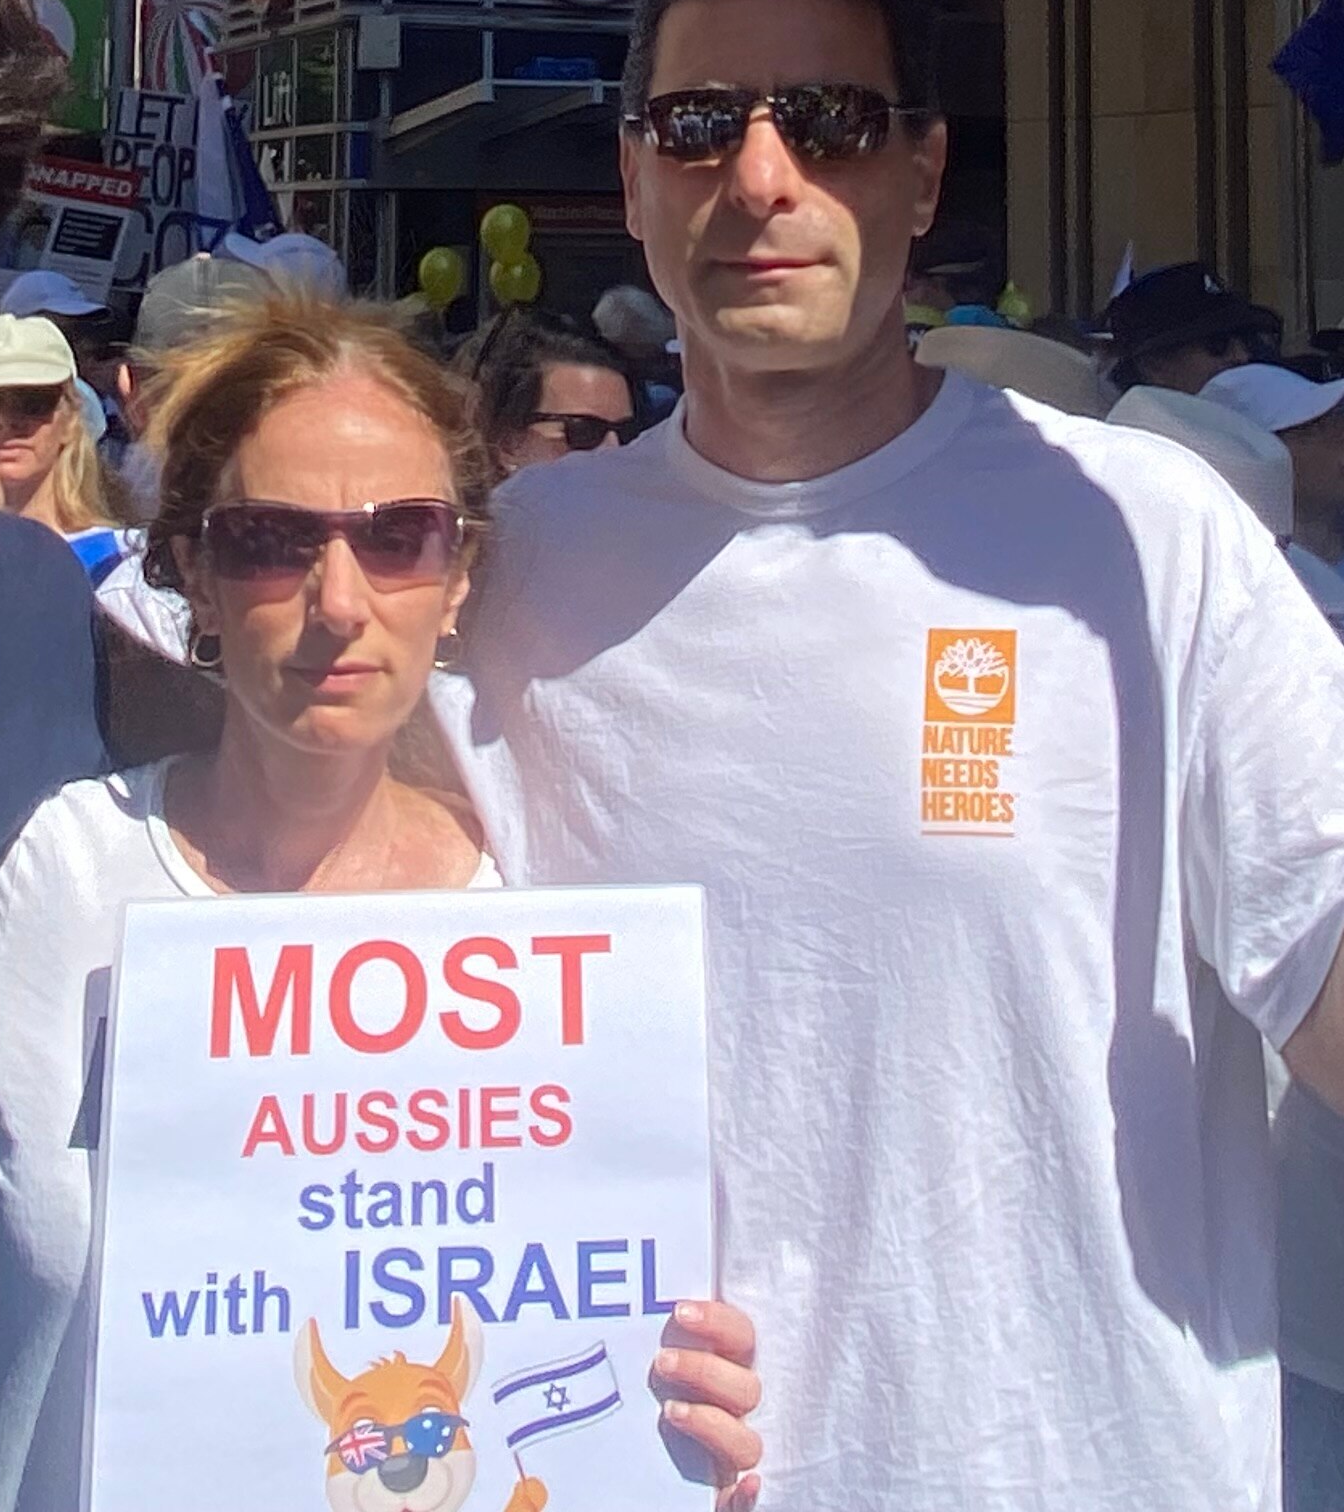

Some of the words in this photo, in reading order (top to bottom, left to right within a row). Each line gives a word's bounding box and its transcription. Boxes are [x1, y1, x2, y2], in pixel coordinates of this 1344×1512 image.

[113, 90, 186, 137] LET
[35, 164, 133, 198] NAPPED
[111, 140, 197, 208] PEOP
[923, 724, 1014, 756] NATURE
[921, 757, 999, 789] NEEDS
[921, 791, 1015, 823] HEROES
[209, 933, 611, 1058] MOST
[241, 1084, 573, 1157] AUSSIES
[298, 1162, 496, 1231] stand
[141, 1270, 291, 1338] with
[344, 1238, 678, 1330] ISRAEL
